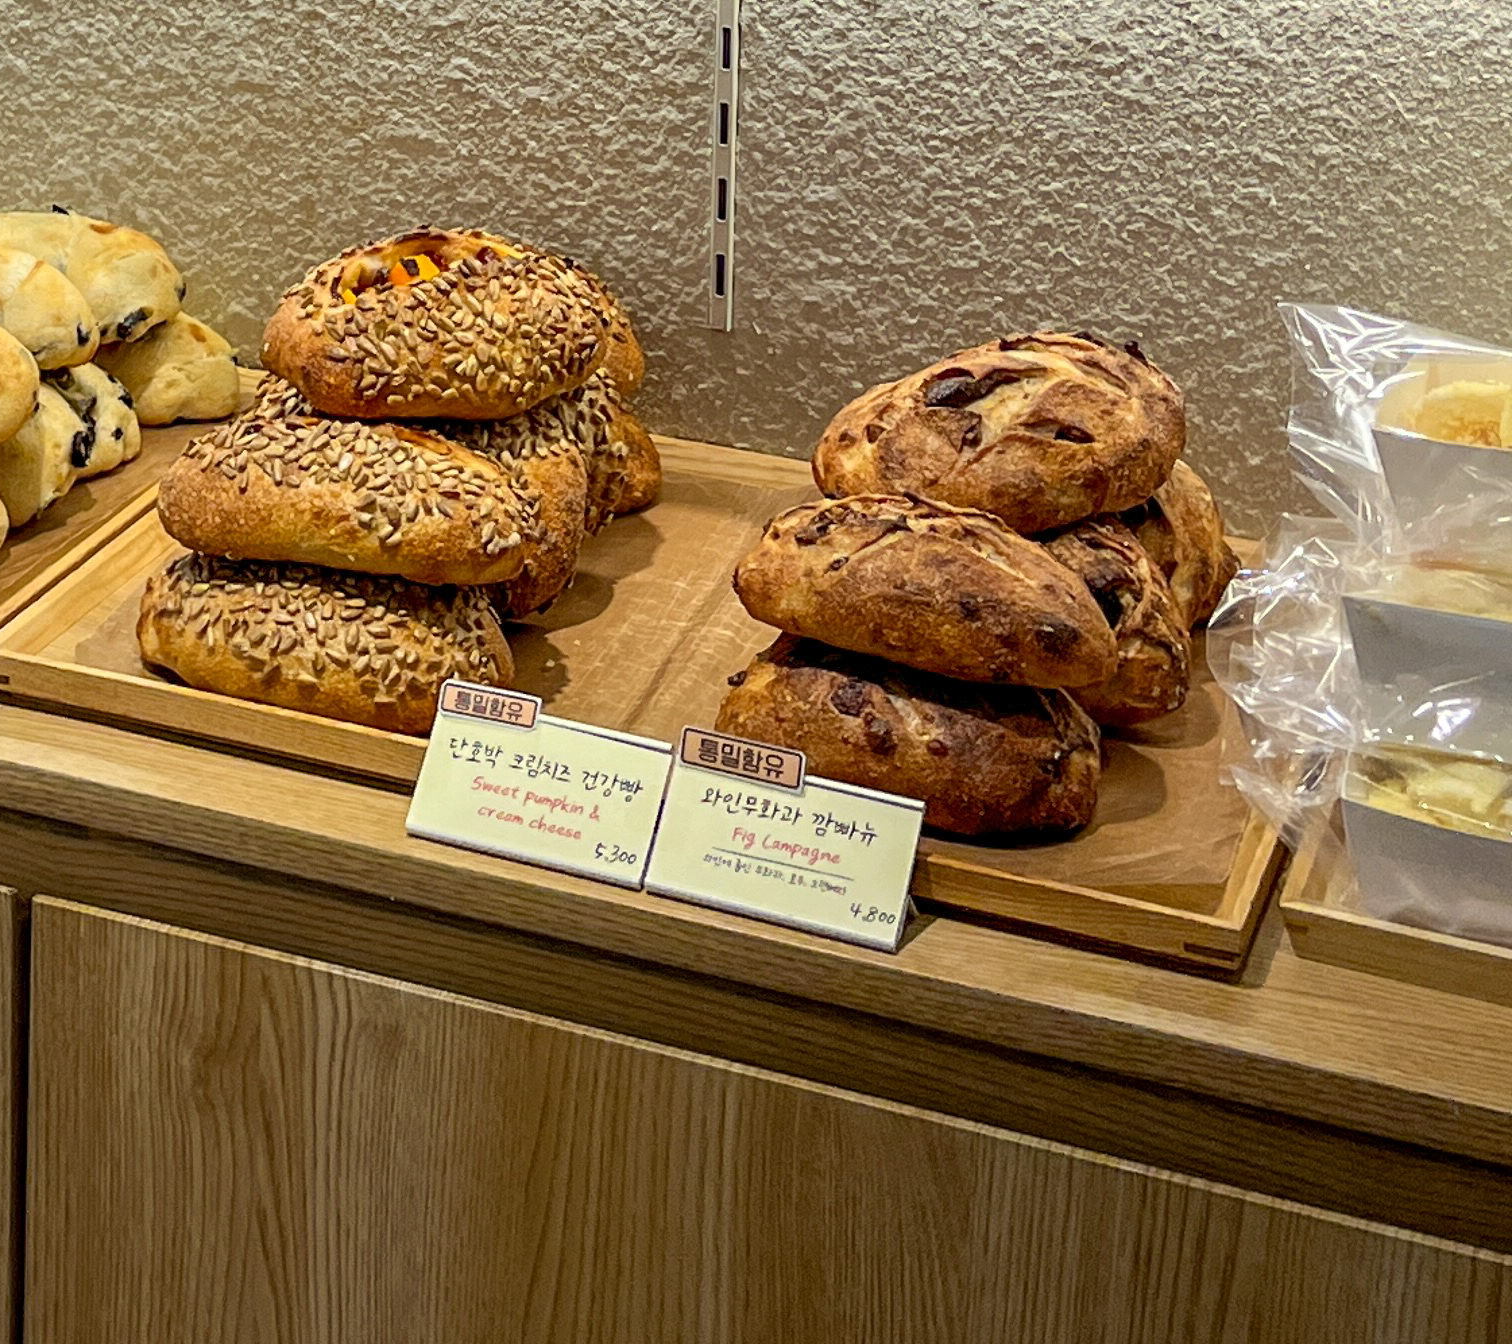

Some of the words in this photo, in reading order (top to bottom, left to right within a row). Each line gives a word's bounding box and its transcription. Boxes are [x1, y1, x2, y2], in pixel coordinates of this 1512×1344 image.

[454, 690, 524, 722] 통밀함유
[449, 736, 505, 769] 단호박
[508, 753, 572, 784] 크림치즈
[581, 769, 644, 803] 건강빵
[698, 737, 785, 779] 통밀함유
[471, 775, 521, 799] Sweet
[522, 790, 585, 816] pumpkin
[589, 803, 601, 823] &
[700, 787, 803, 826] 와인무화과
[811, 811, 879, 847] 깜빠뉴
[477, 805, 524, 826] cream
[528, 815, 582, 840] cheese
[731, 826, 756, 850] Fig
[761, 833, 842, 866] Campagne
